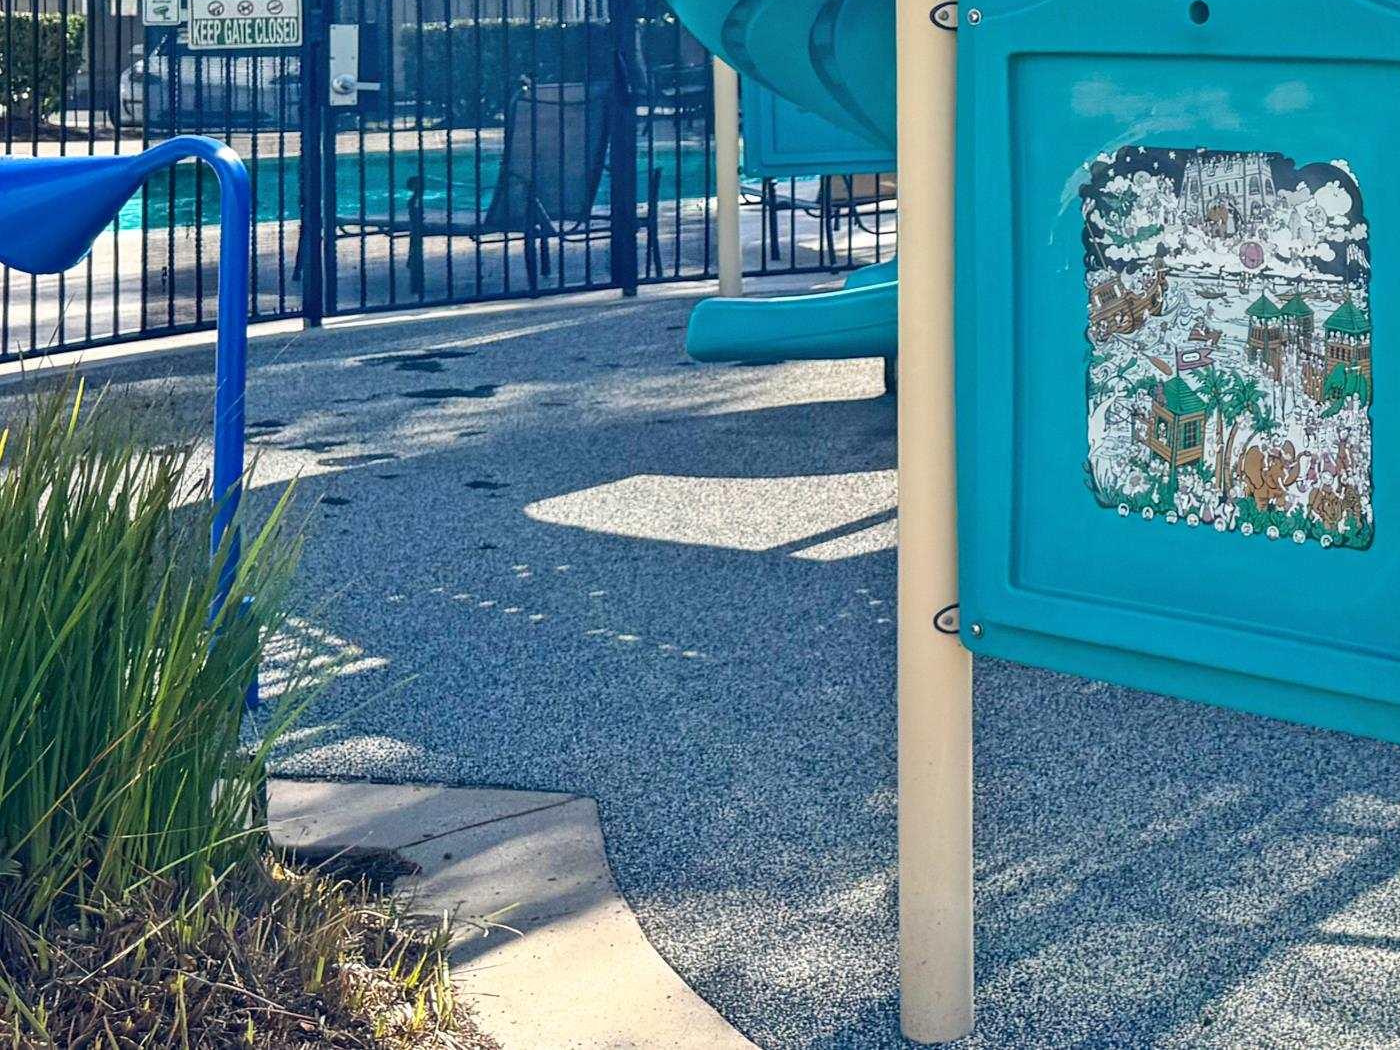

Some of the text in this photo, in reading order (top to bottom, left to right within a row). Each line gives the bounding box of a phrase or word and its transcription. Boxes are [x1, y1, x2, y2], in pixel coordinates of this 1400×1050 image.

[193, 17, 298, 45] KEEP GATE CLOSED
